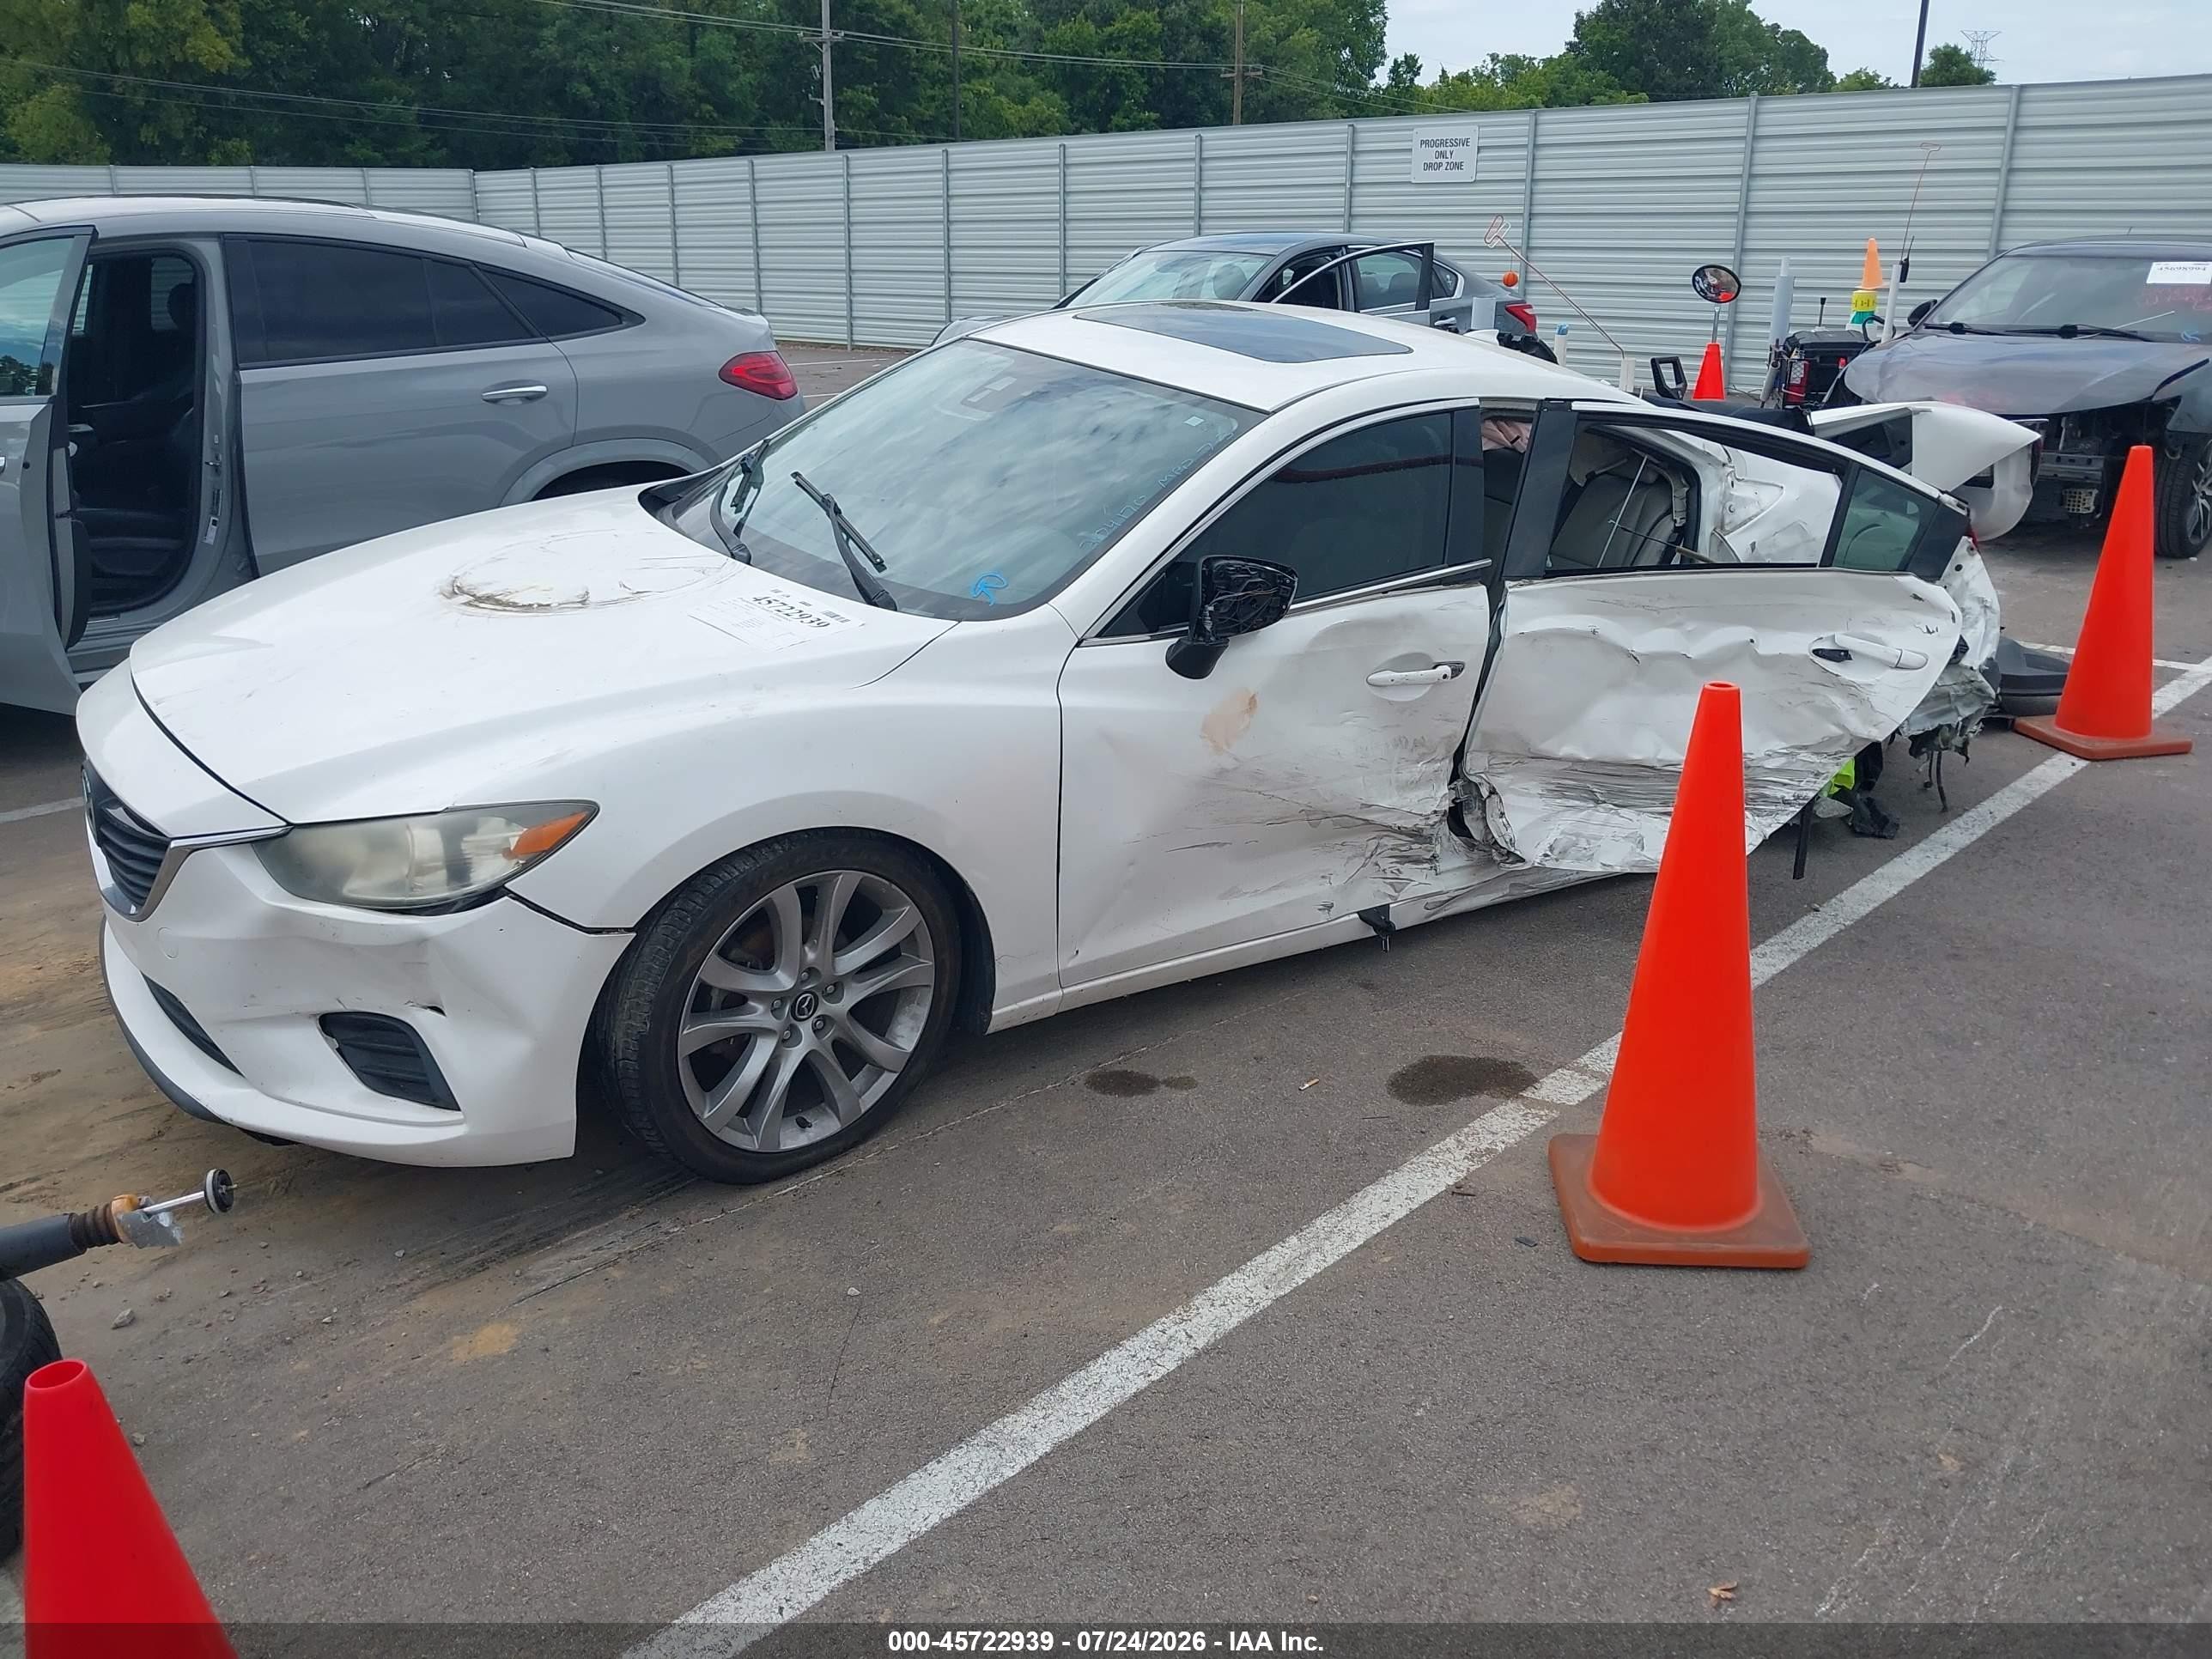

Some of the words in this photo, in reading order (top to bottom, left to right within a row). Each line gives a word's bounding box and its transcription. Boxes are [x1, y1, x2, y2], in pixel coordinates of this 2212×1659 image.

[1420, 137, 1470, 149] PROGRESSIVE
[1435, 150, 1454, 159] ONLY
[1423, 161, 1443, 172] DROP
[1444, 161, 1464, 171] ZONE
[752, 595, 832, 629] 45722939
